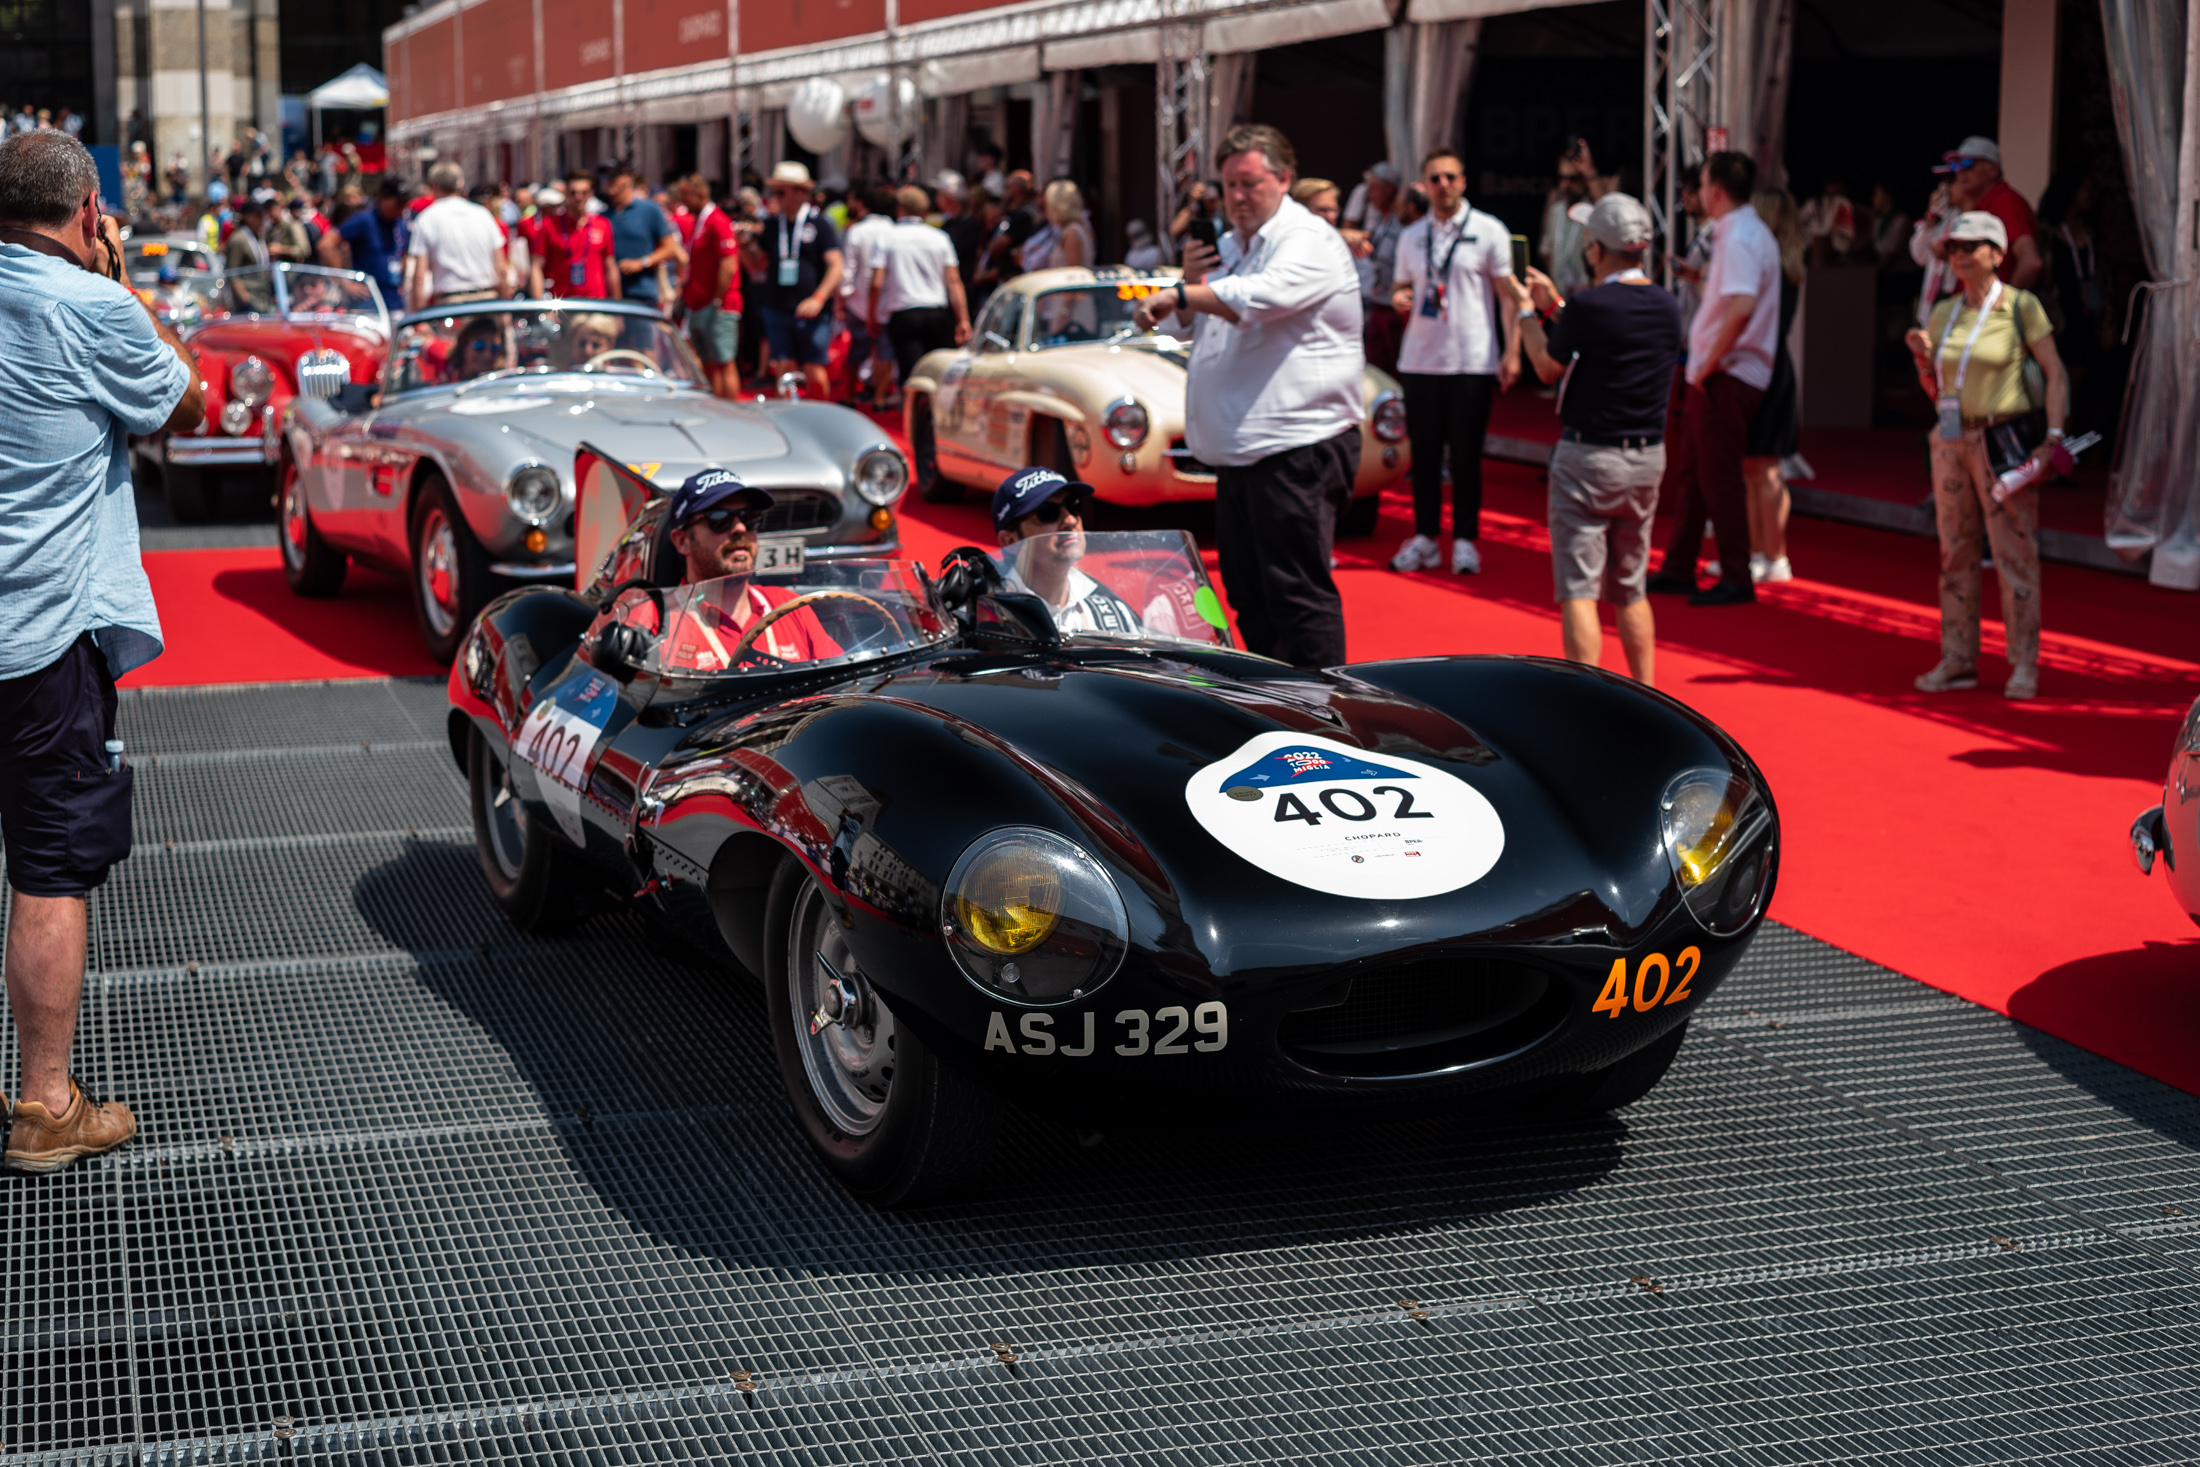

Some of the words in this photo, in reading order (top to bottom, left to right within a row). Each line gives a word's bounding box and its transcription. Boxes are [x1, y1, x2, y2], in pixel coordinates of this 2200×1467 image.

[526, 719, 581, 780] 402
[1283, 751, 1323, 763] 2022
[1289, 759, 1327, 768] 1000
[1293, 764, 1331, 773] MIGLIA
[1273, 785, 1435, 826] 402
[1344, 831, 1402, 841] CHOPARD
[1591, 945, 1701, 1019] 402
[984, 1011, 1095, 1057] ASJ
[1114, 1001, 1228, 1057] 329
